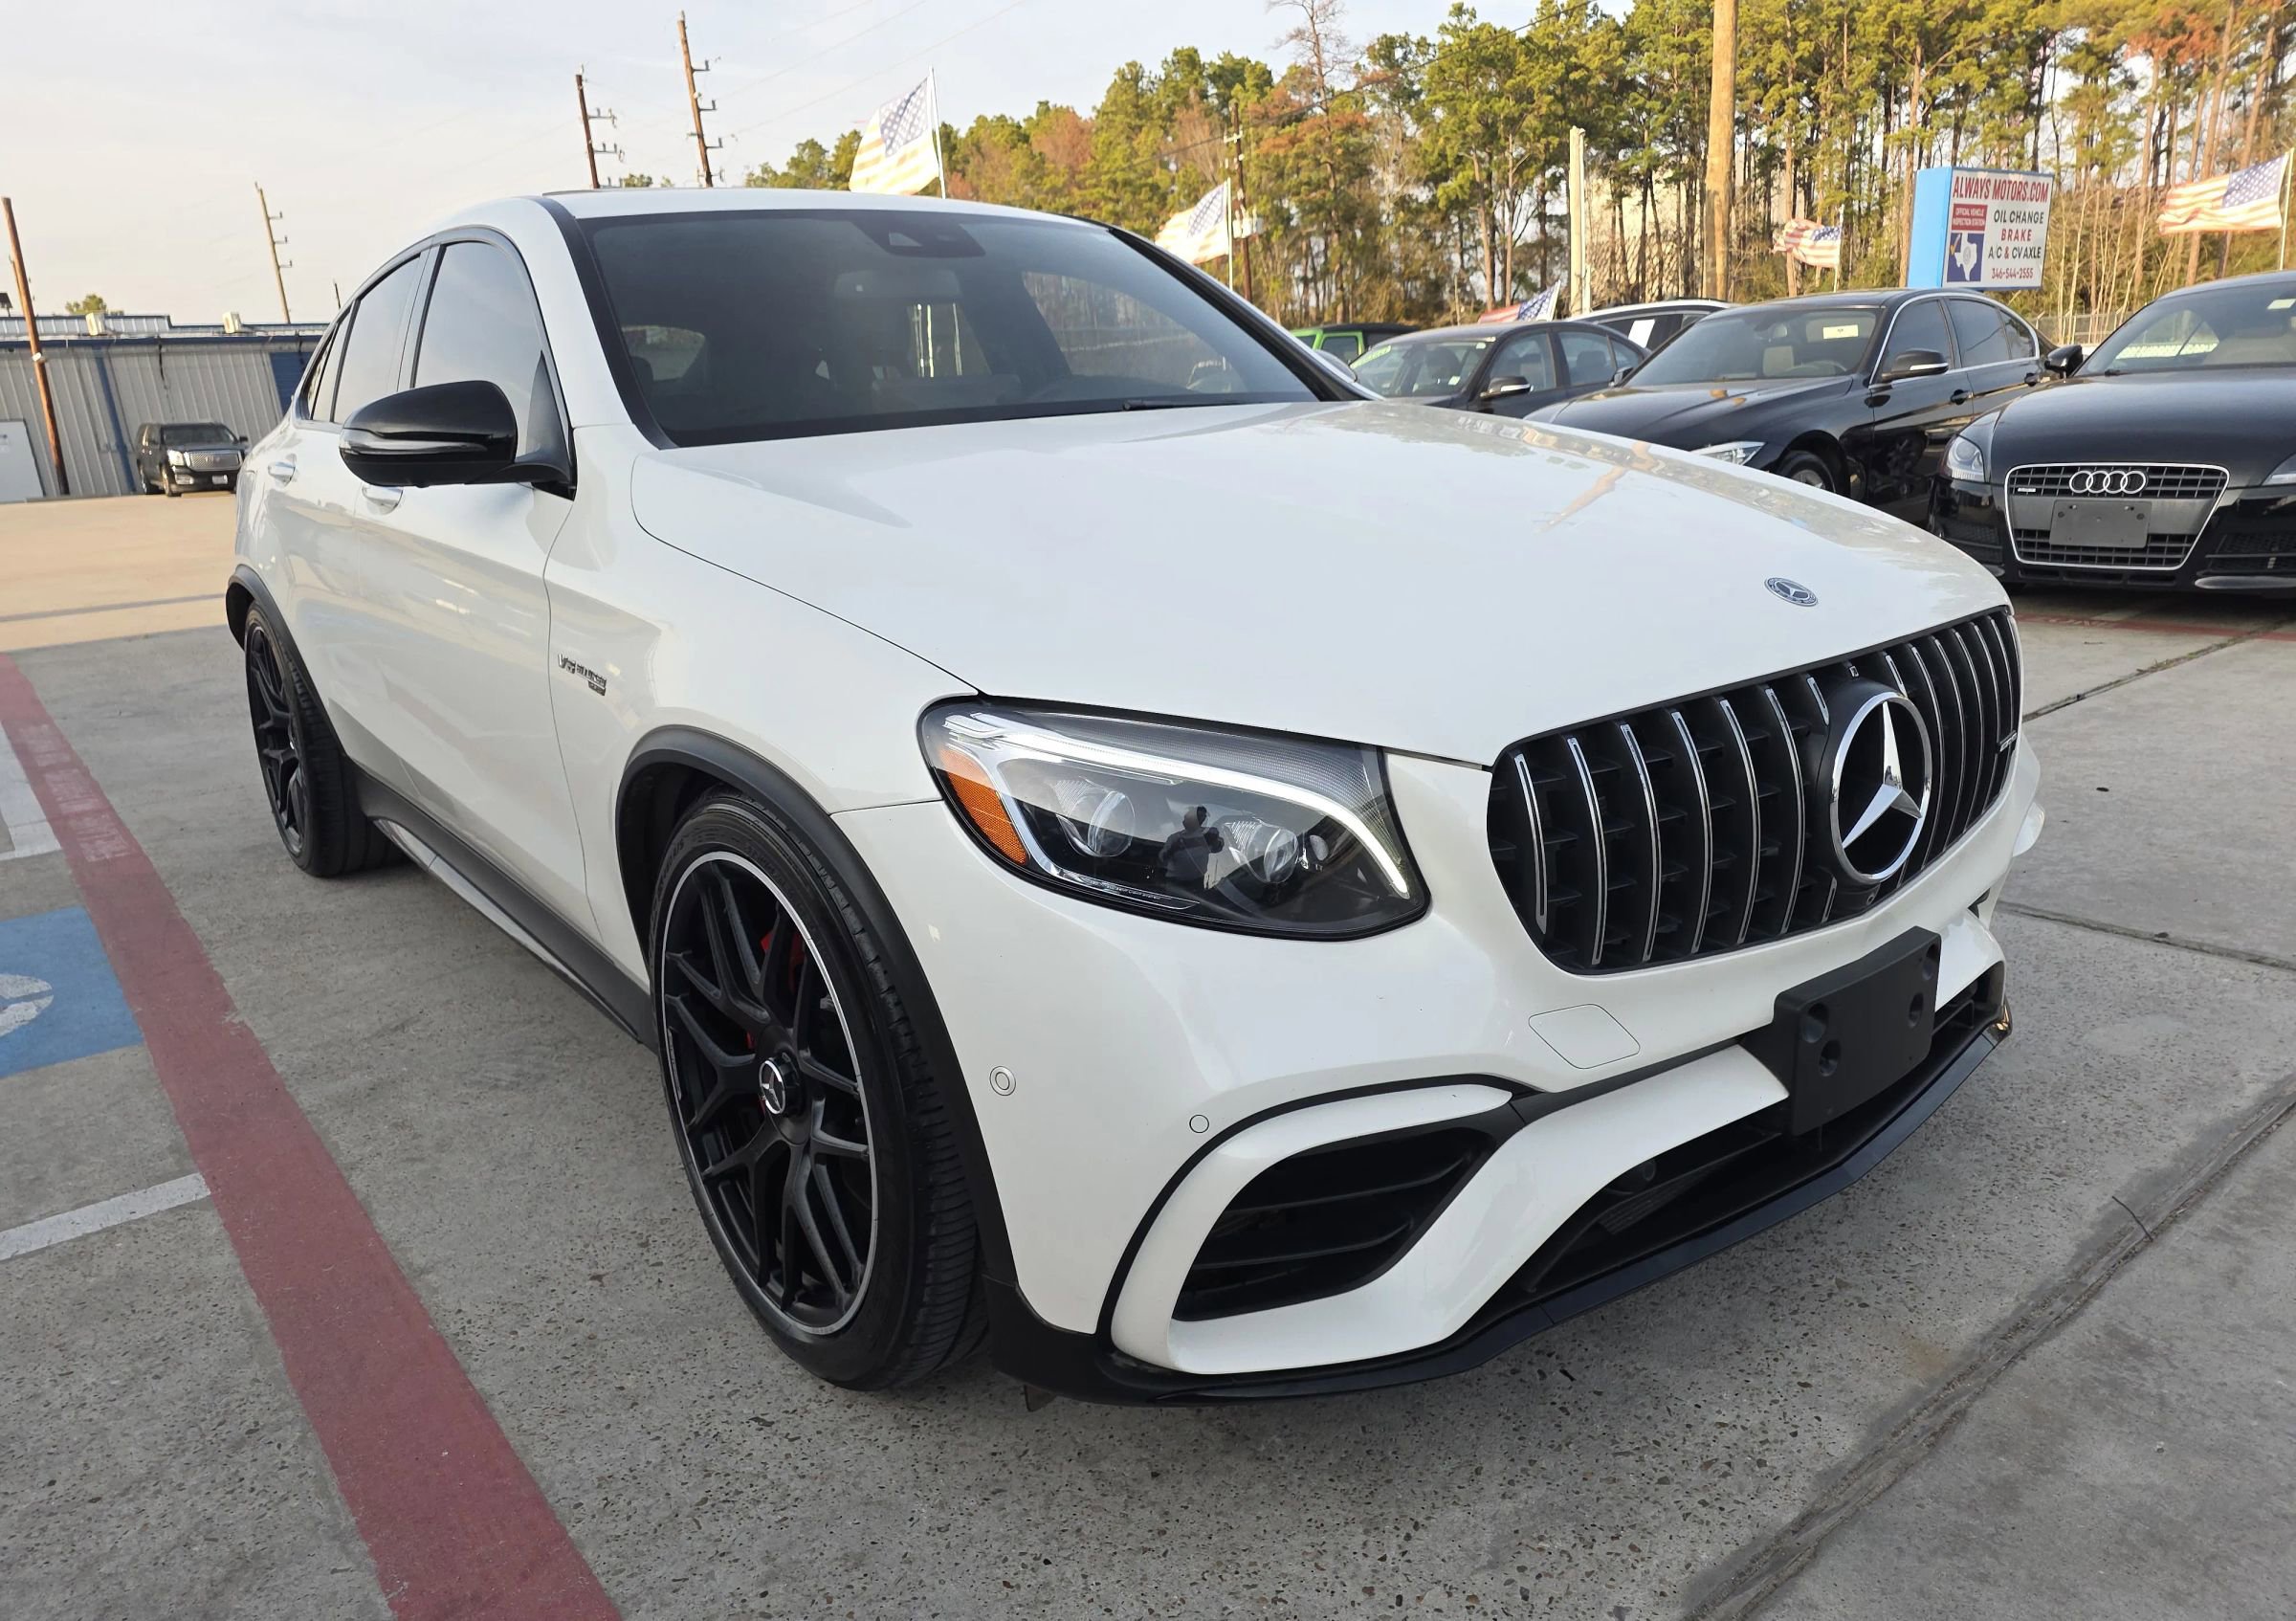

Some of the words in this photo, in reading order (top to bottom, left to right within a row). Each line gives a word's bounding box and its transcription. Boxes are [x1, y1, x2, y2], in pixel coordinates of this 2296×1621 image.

[1953, 176, 1991, 199] ALWAYS
[1992, 179, 2048, 203] MOTORS.COM
[1994, 210, 2007, 223] OIL
[2009, 211, 2044, 225] CHANGE
[2001, 229, 2032, 242] BRAKE
[2004, 246, 2010, 259] &
[1992, 267, 2034, 279] 346-544-2555
